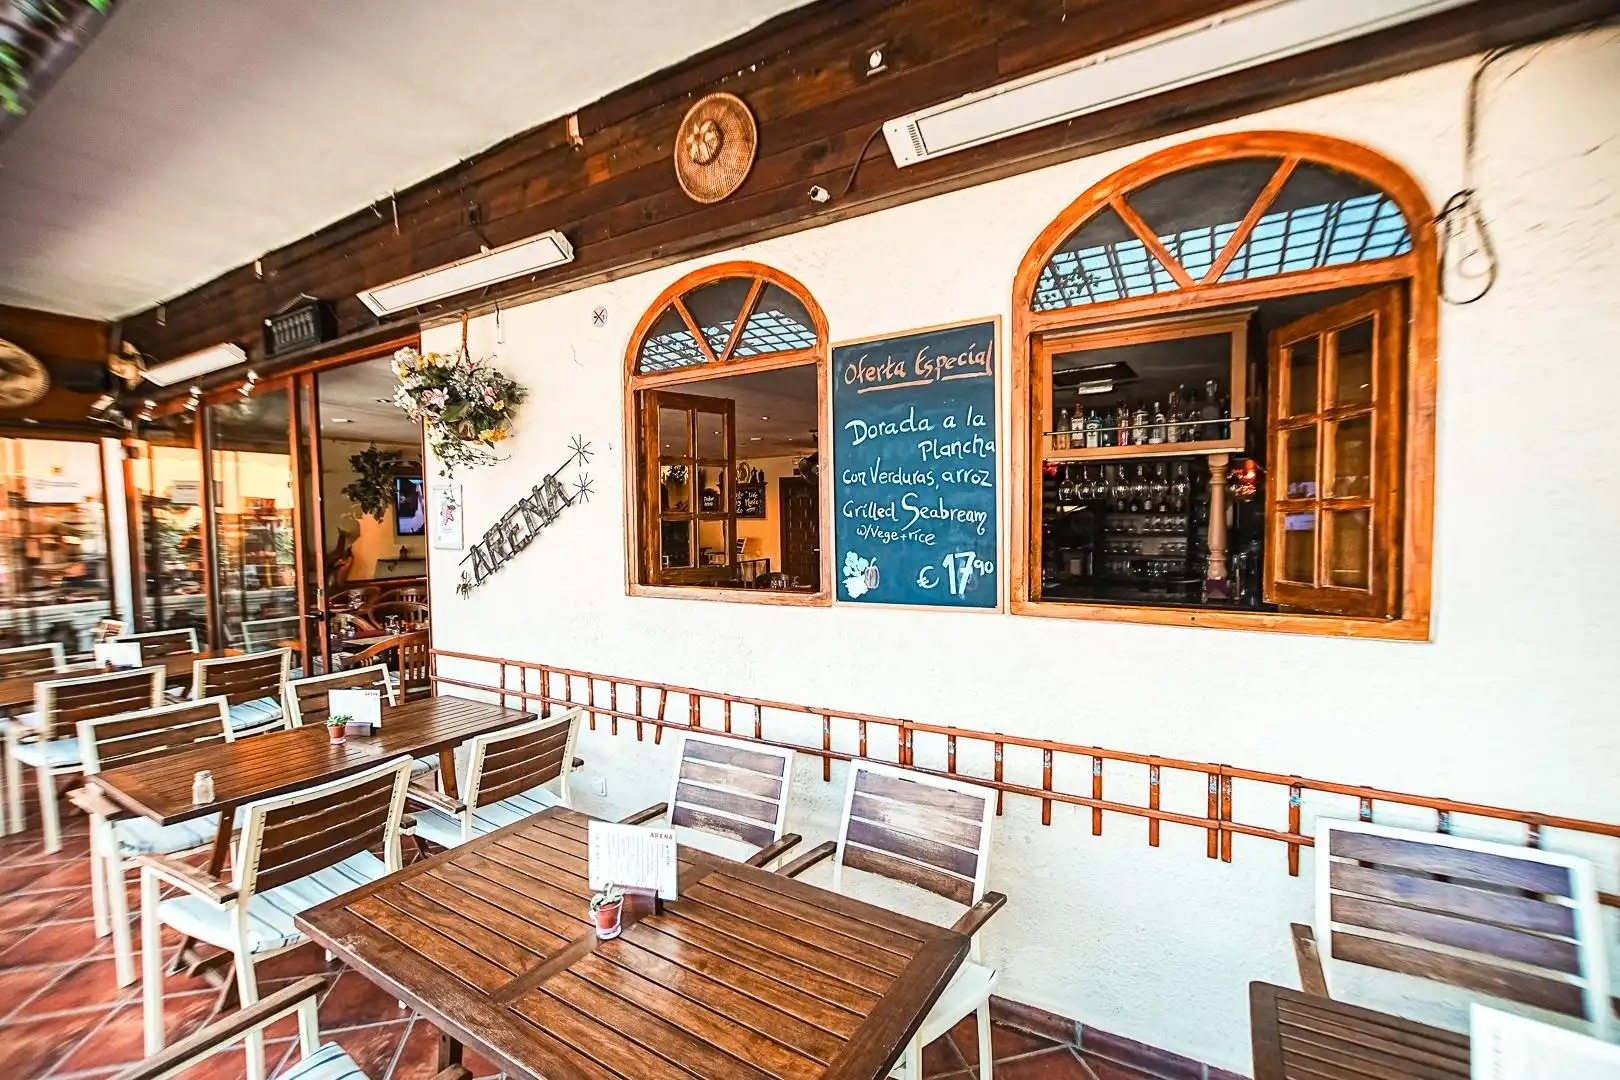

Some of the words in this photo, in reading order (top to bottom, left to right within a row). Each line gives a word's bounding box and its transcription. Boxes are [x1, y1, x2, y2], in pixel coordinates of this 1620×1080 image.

[844, 354, 906, 385] Oferta
[844, 406, 934, 446] Dorada
[943, 413, 957, 429] a
[966, 405, 987, 427] la
[917, 433, 995, 461] Plancha
[942, 468, 993, 488] arroz
[469, 474, 572, 584] ARENA
[842, 499, 899, 521] Grilled
[901, 492, 988, 535] Seabream
